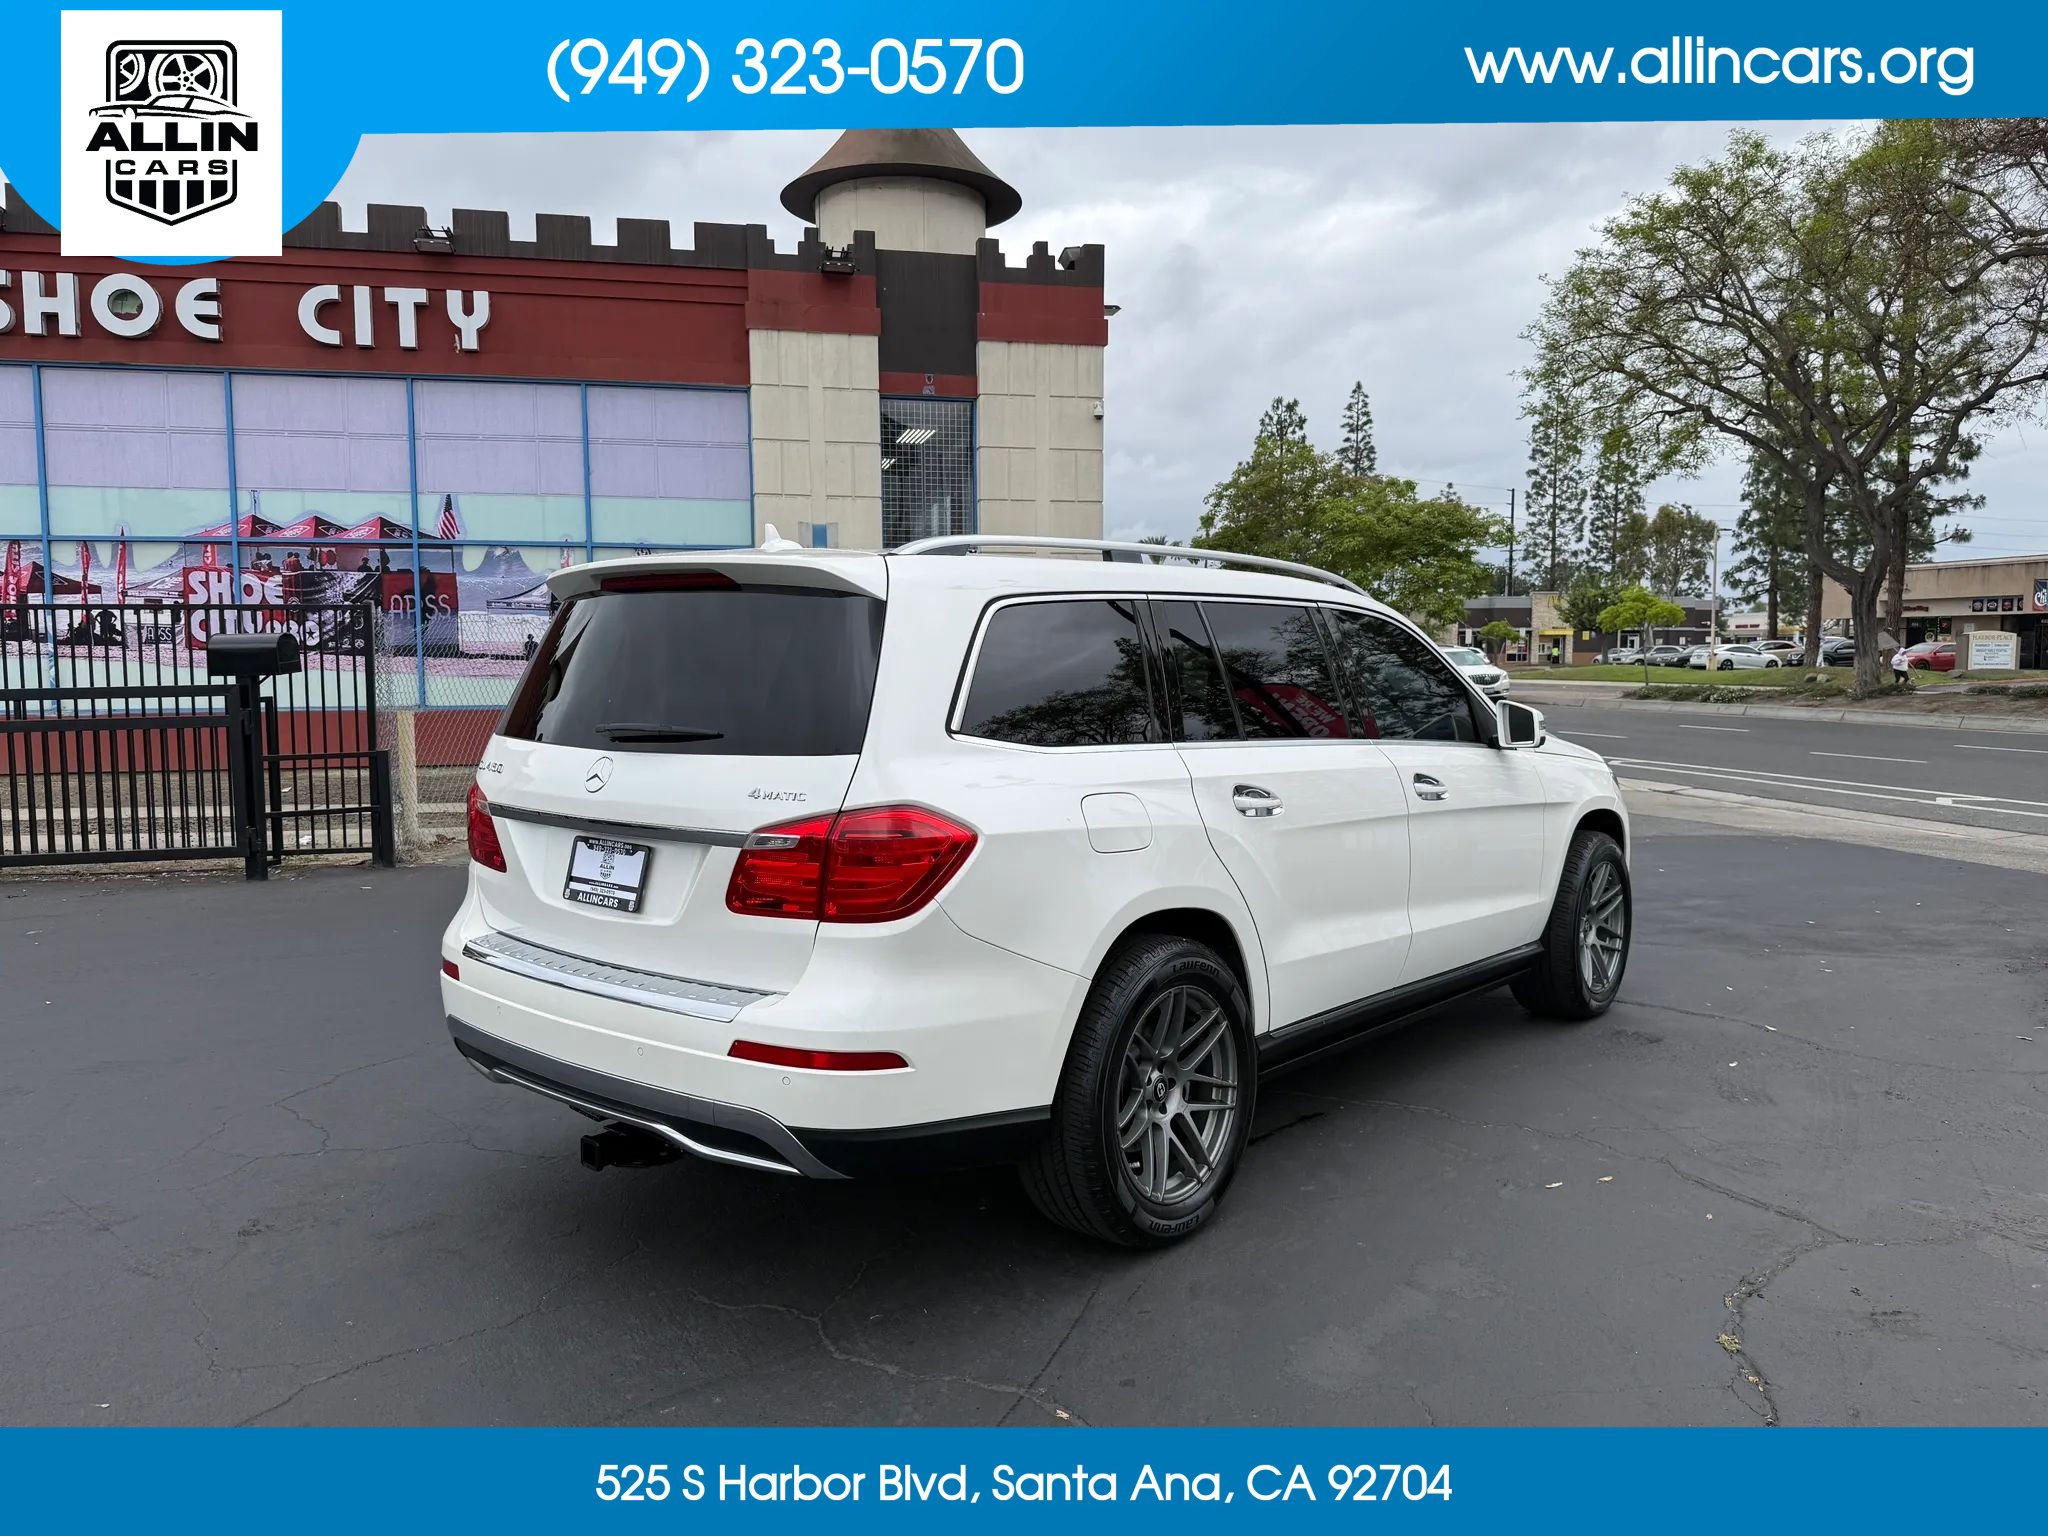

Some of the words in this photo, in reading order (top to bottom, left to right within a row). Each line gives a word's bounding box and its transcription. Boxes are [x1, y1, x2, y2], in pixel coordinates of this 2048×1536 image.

[0, 269, 222, 341] HOE
[298, 284, 492, 352] CITY
[188, 570, 284, 606] SHOE
[747, 786, 807, 802] 4MATIC
[577, 892, 619, 908] ALLINCARS
